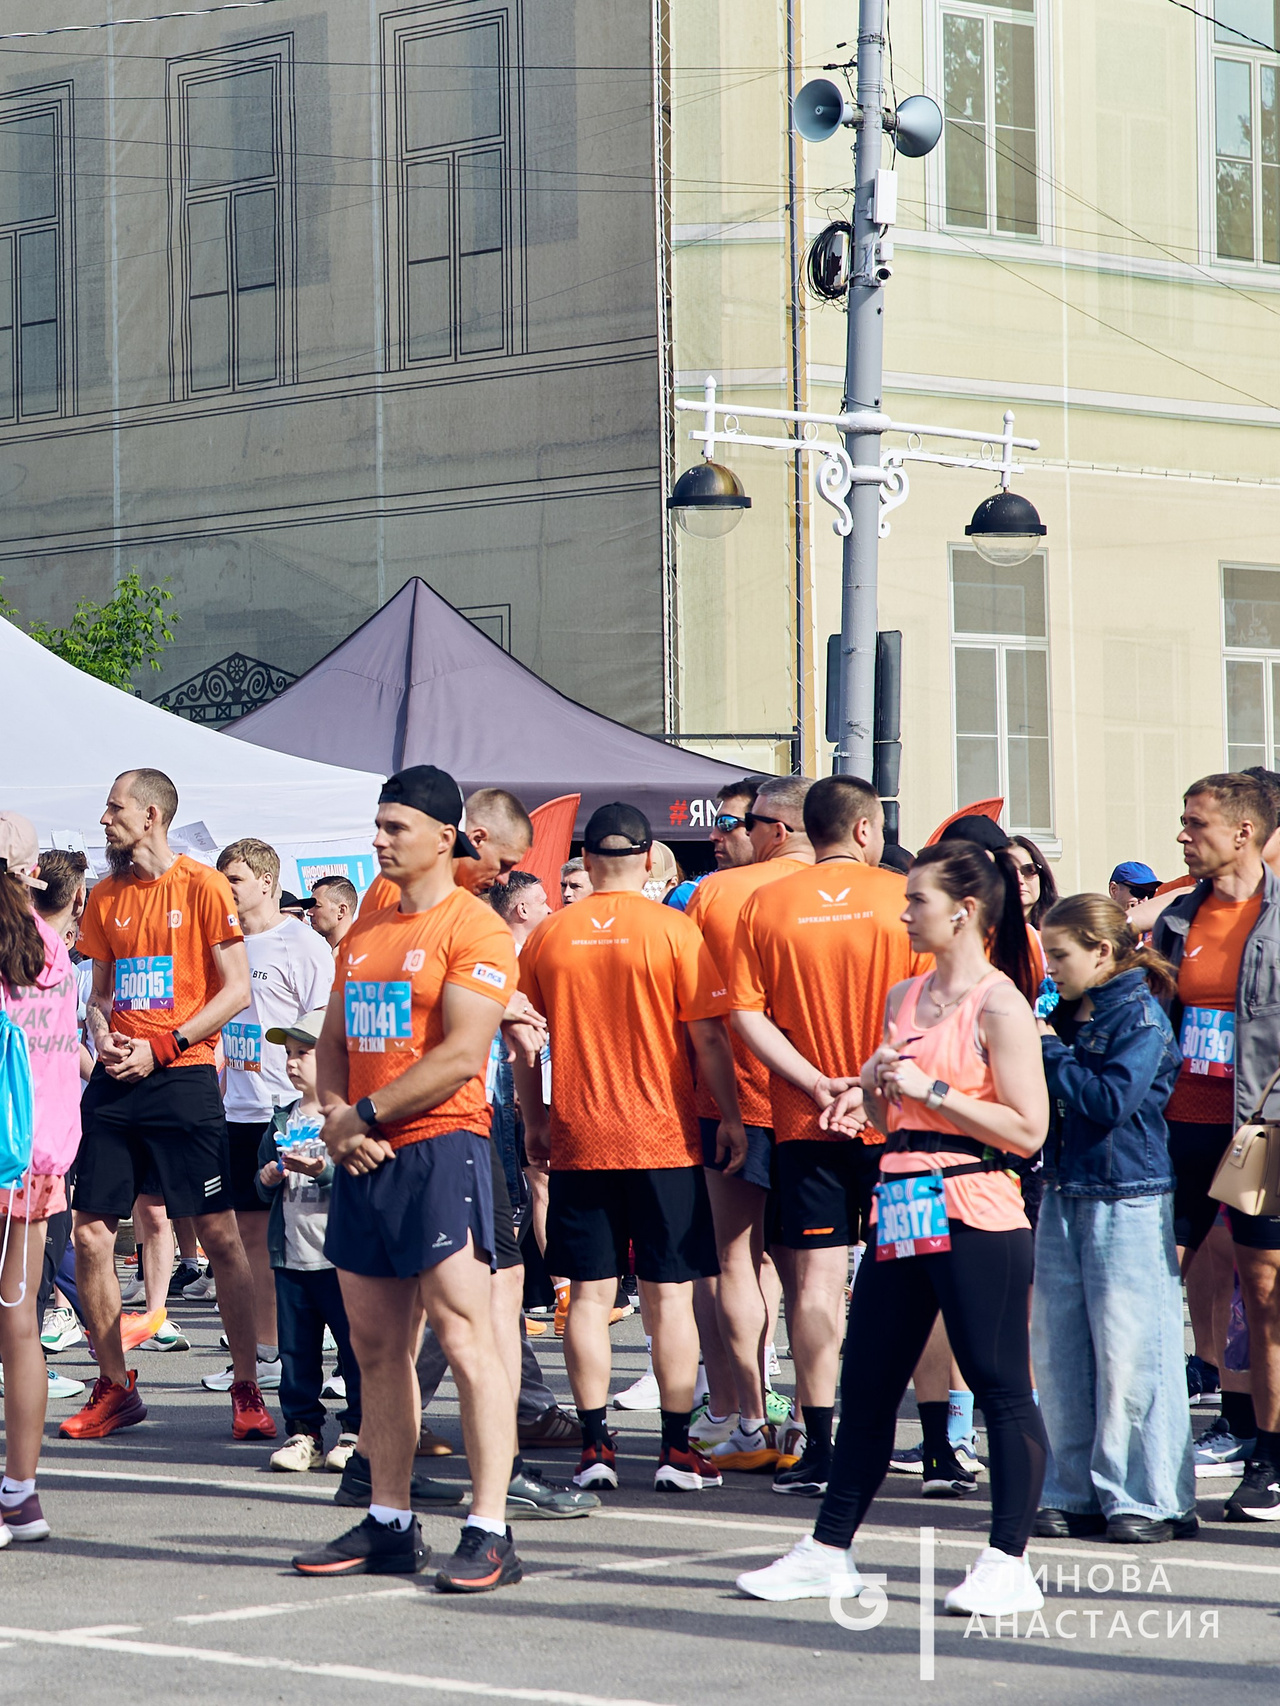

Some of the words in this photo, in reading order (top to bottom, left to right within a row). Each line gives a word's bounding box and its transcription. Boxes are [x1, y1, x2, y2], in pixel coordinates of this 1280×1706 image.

[402, 949, 426, 972] 10
[120, 971, 165, 999] 50015
[252, 970, 268, 980] ВТБ
[130, 998, 151, 1010] 10KM
[10, 1007, 52, 1029] КАК
[351, 1001, 397, 1037] 70141
[1183, 1025, 1235, 1063] 30139
[1190, 1059, 1210, 1075] 5KM
[882, 1198, 933, 1242] 30317
